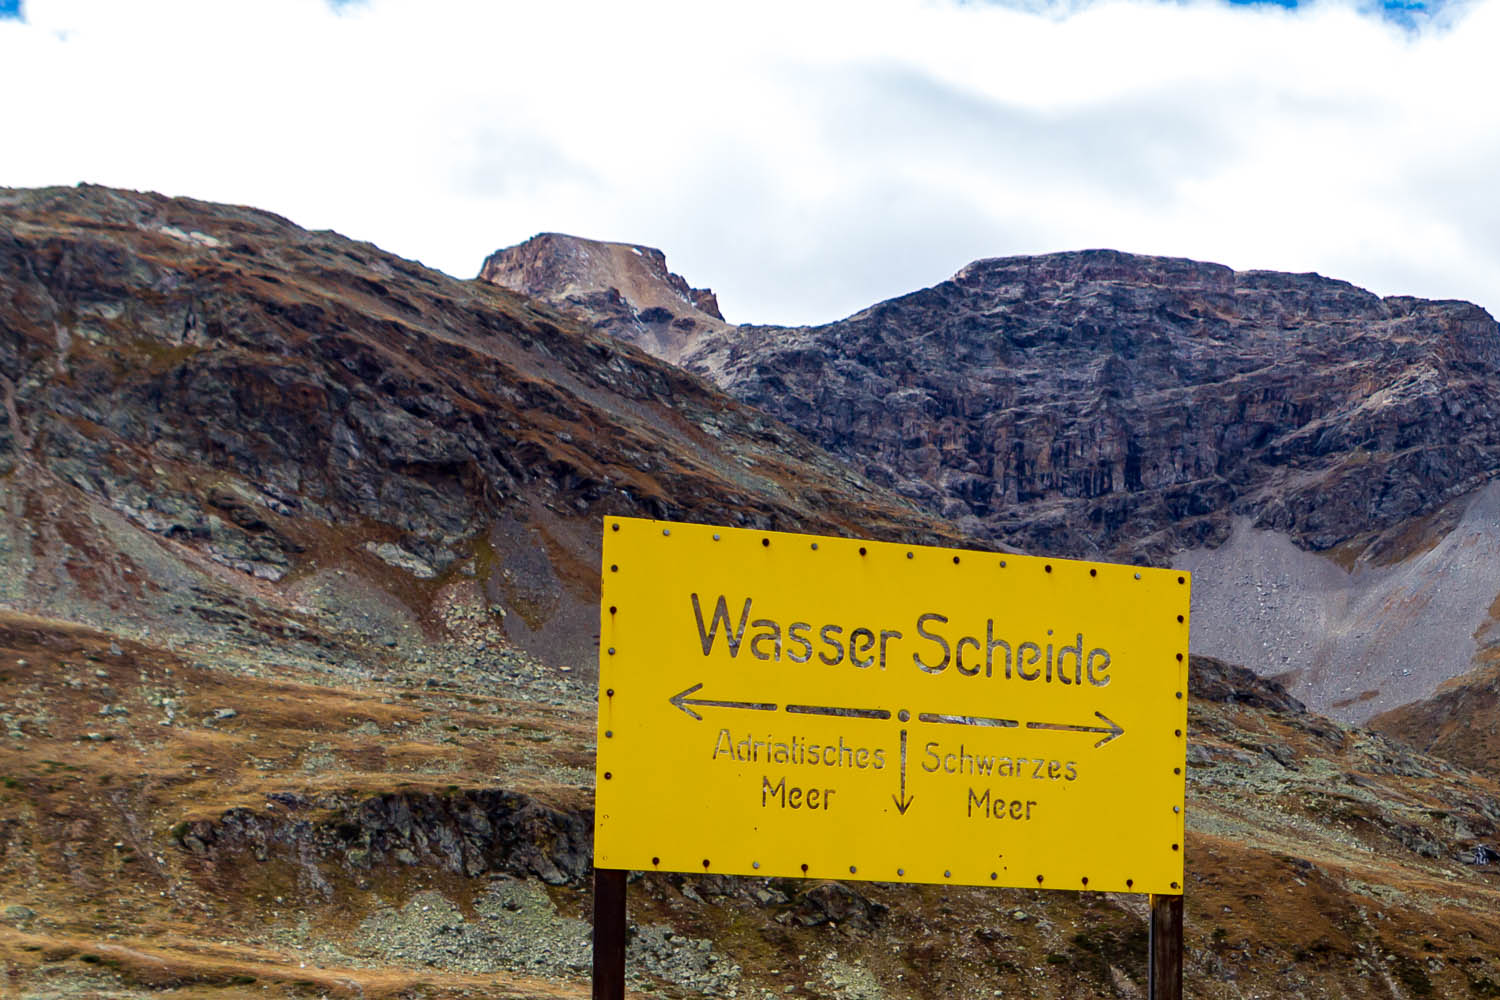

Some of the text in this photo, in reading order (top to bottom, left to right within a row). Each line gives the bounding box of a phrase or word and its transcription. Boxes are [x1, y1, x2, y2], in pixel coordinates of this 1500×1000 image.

[690, 592, 1112, 688] Wasser Scheide
[712, 728, 886, 770] Adriatisches
[920, 741, 1078, 782] Schwarzes
[761, 775, 836, 811] Meer
[967, 787, 1038, 821] Meer
